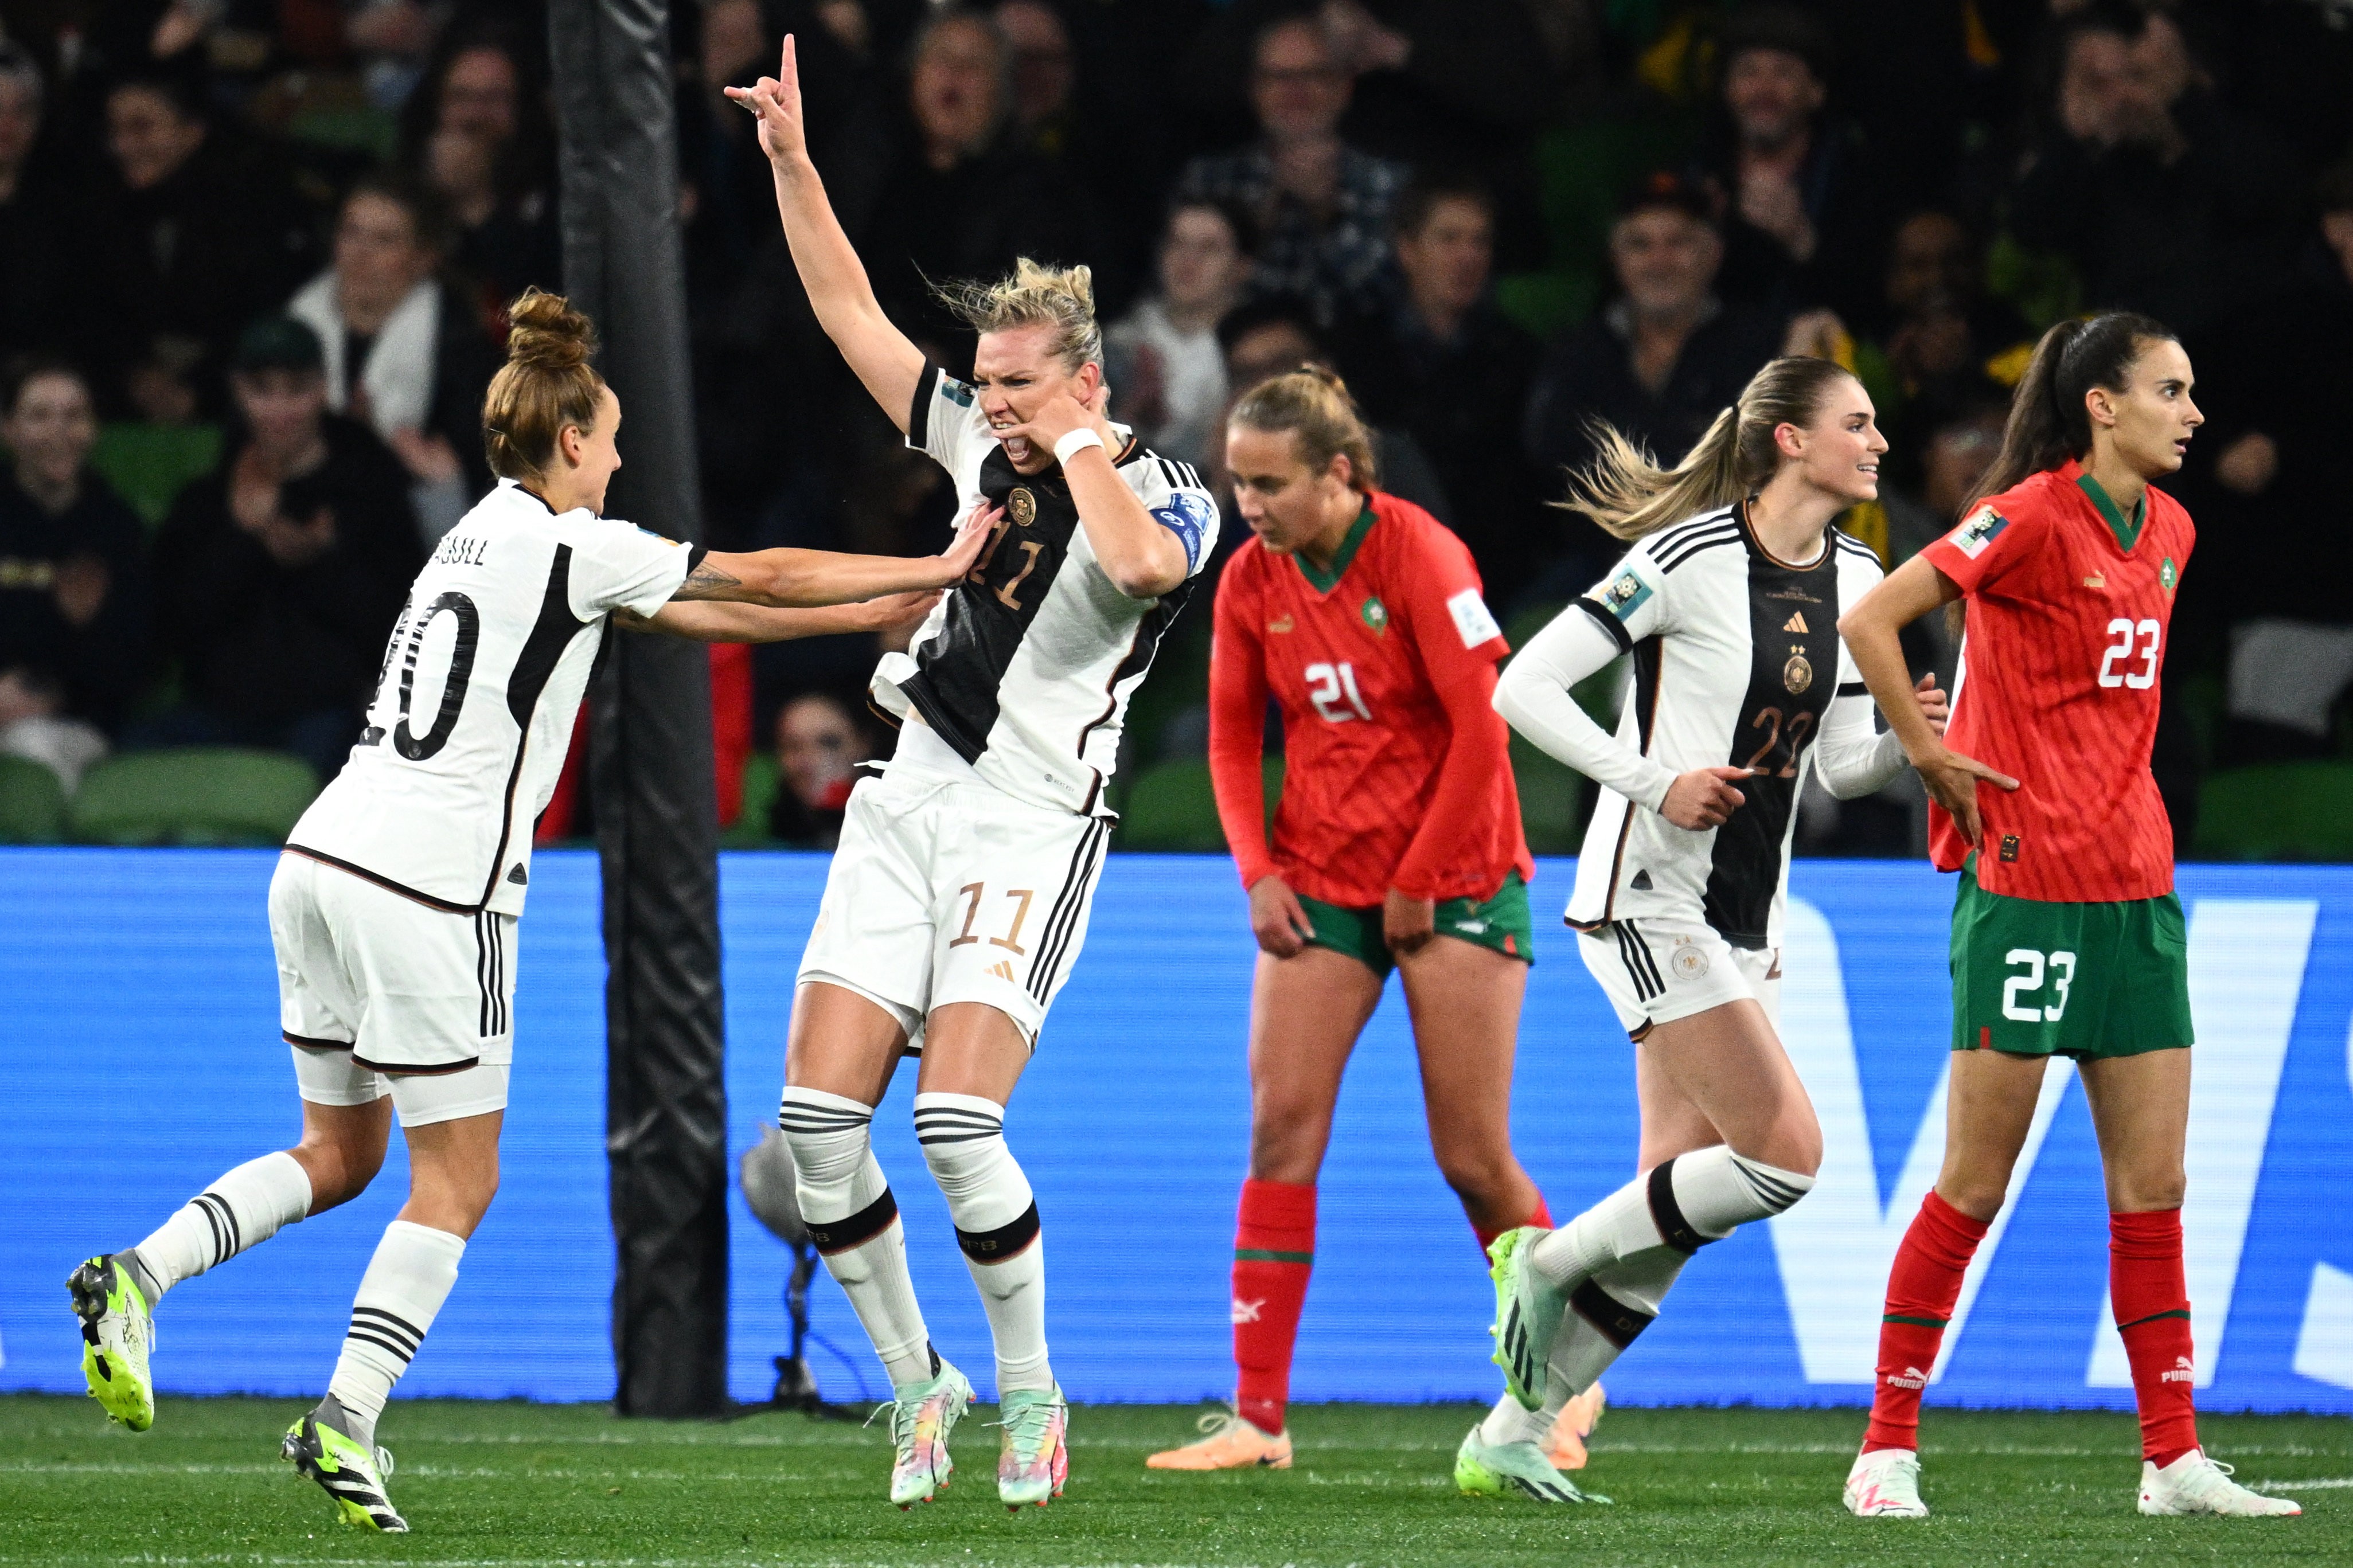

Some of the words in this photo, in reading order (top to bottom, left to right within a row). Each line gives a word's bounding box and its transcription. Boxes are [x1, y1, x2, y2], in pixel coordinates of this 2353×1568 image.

[968, 520, 1045, 611] 11
[2098, 619, 2160, 689] 23
[1304, 661, 1372, 722] 21
[1746, 706, 1814, 778] 22
[950, 881, 1033, 956] 11
[2002, 949, 2076, 1022] 23
[1767, 893, 2353, 1390] VI
[1887, 1375, 1924, 1390] PUMA
[2161, 1370, 2194, 1383] PUM
